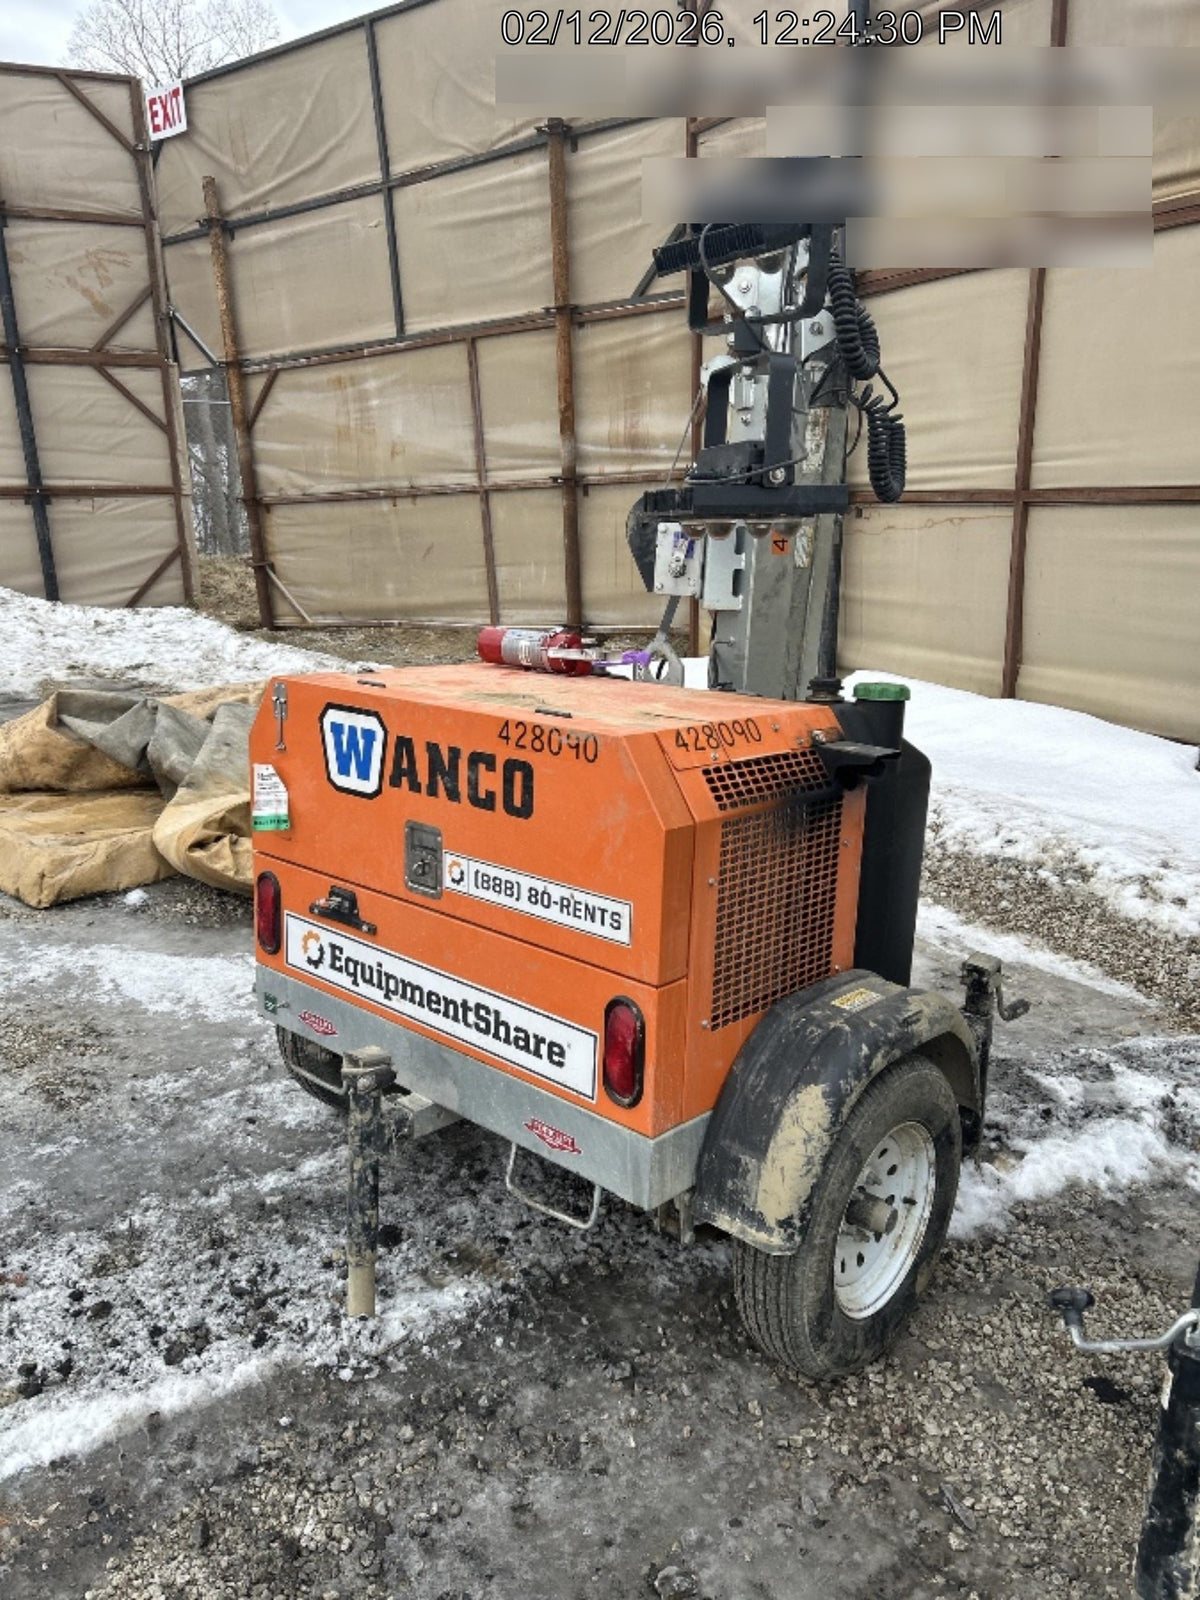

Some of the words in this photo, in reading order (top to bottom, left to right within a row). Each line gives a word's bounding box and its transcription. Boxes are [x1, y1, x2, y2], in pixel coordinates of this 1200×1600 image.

[148, 86, 182, 133] EXIT
[773, 537, 788, 552] 4
[498, 719, 599, 763] 428090
[675, 717, 762, 752] 428090
[329, 721, 534, 820] WANCO
[473, 868, 521, 901] (888)
[527, 886, 622, 931] 80-RENTS
[328, 941, 567, 1069] EquipmentShare
